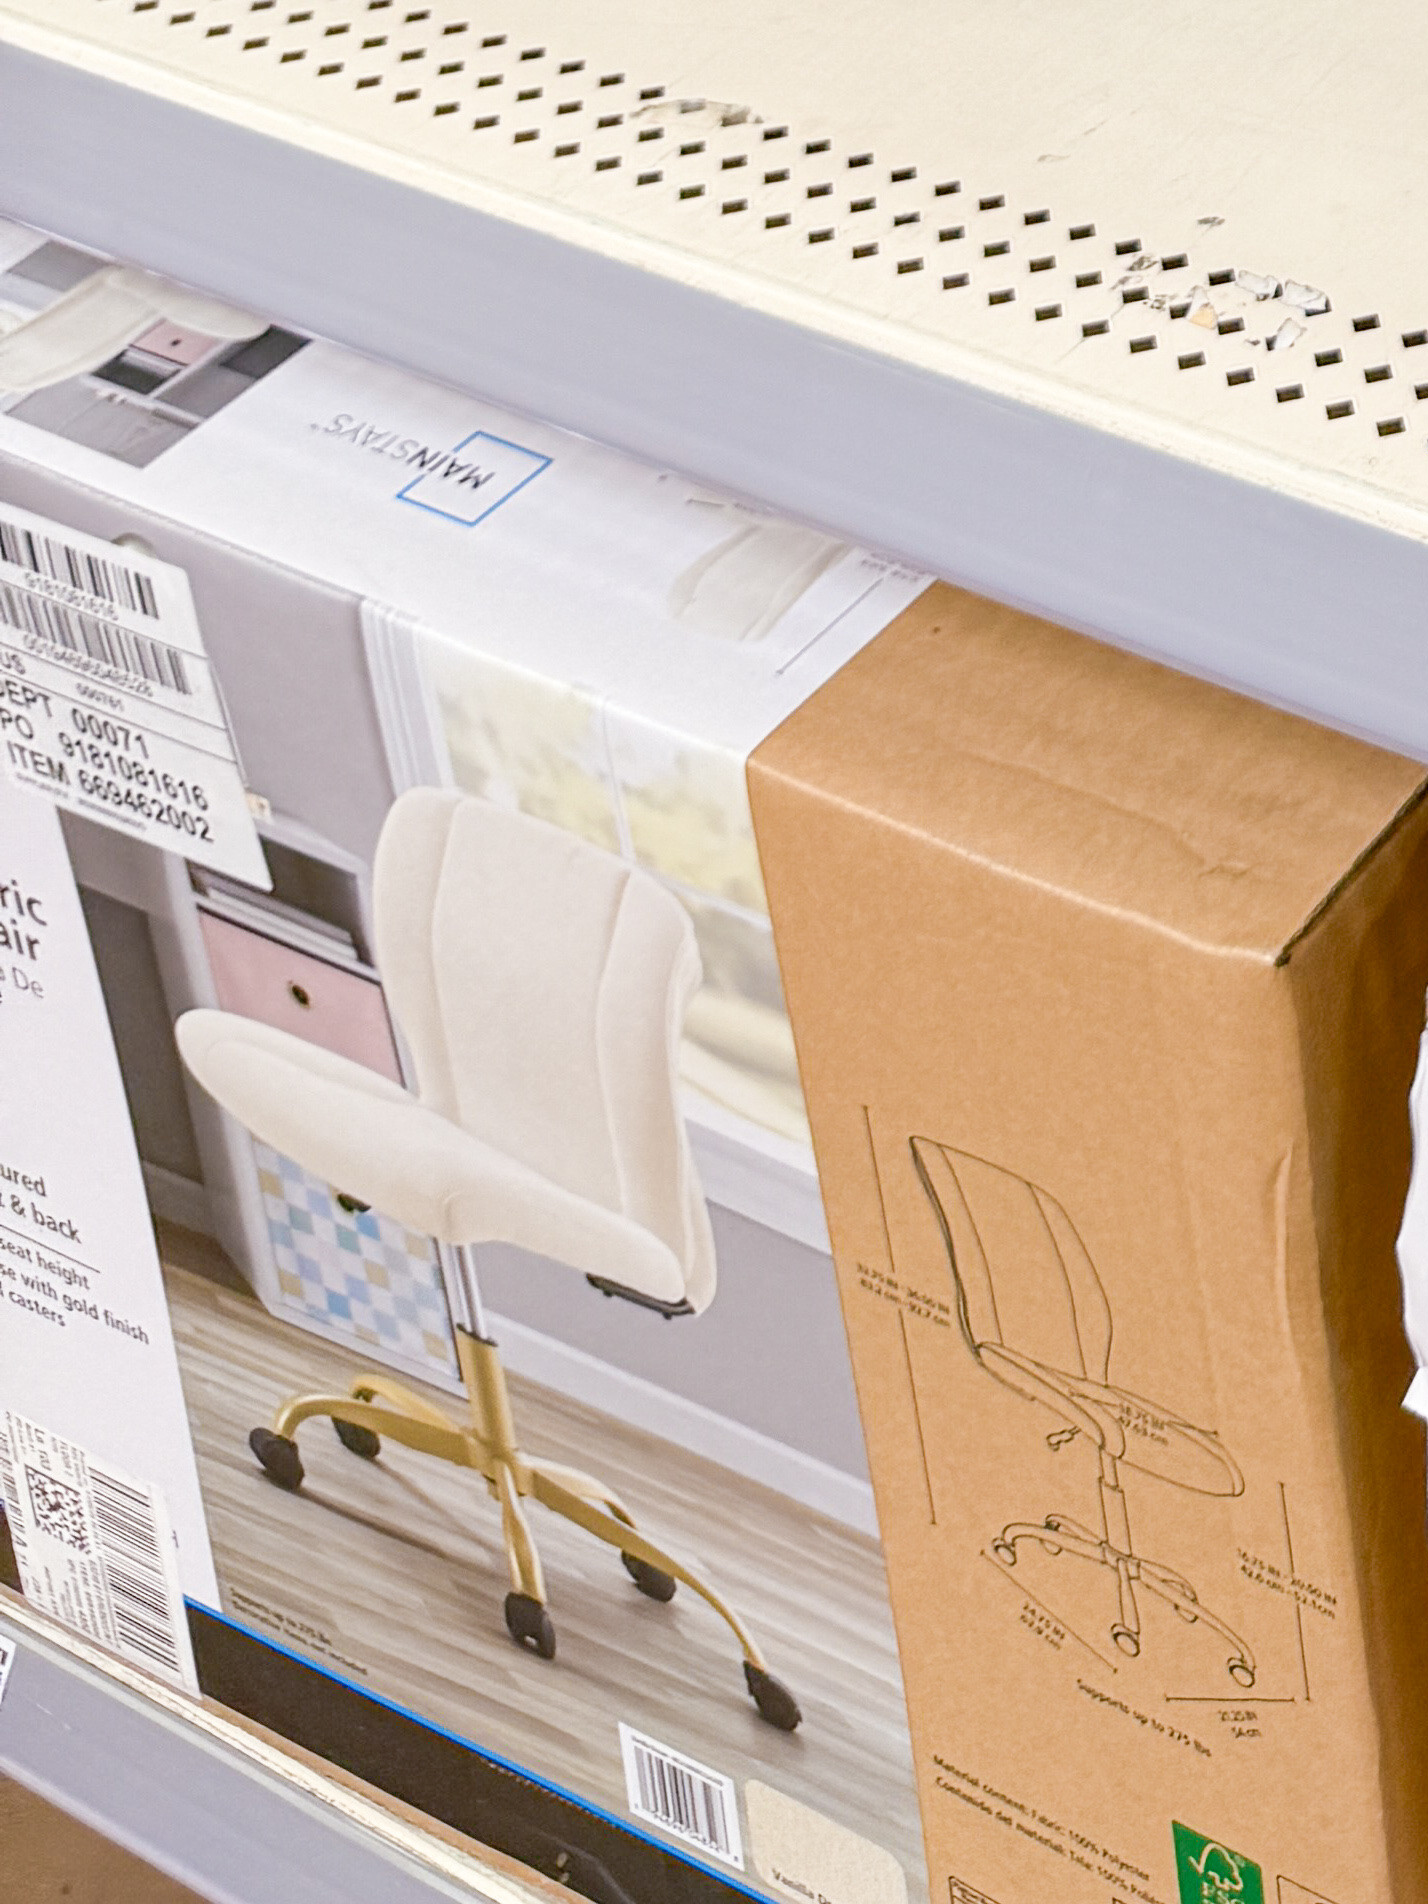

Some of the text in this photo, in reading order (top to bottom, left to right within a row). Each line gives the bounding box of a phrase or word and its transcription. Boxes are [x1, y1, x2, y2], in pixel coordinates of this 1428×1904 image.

[72, 708, 149, 759] 00071
[31, 1202, 82, 1244] back
[21, 1272, 58, 1301] with
[62, 1294, 99, 1321] gold
